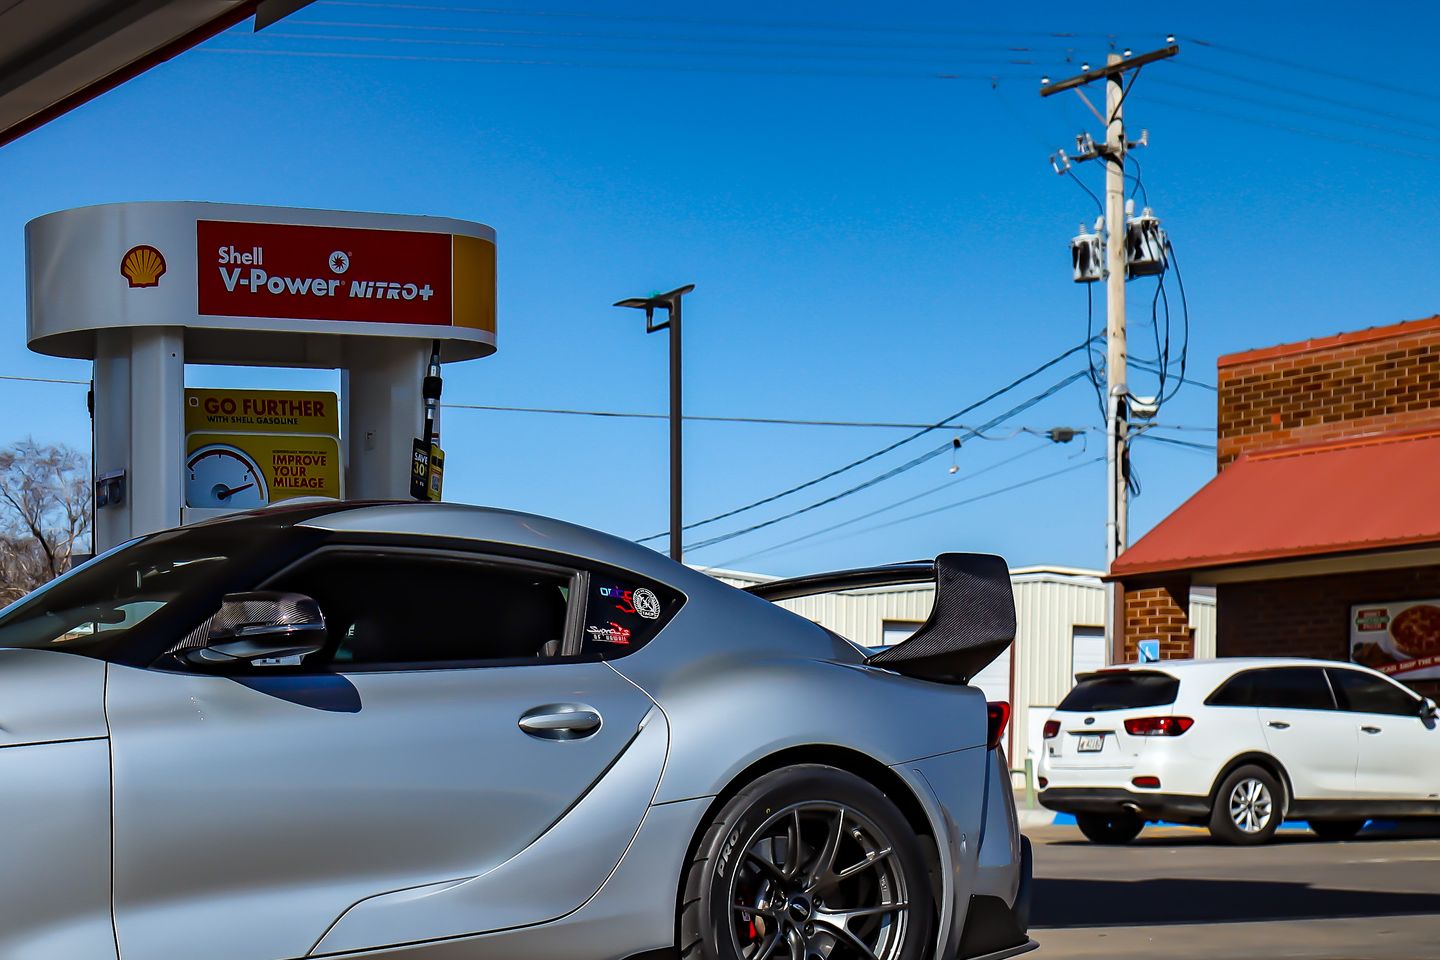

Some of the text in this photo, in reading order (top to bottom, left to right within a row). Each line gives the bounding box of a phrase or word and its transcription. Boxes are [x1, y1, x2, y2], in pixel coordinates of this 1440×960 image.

[218, 245, 263, 265] Shell
[219, 267, 340, 297] V-Power
[204, 397, 326, 417] GO FURTHER
[231, 416, 254, 424] SHELL
[256, 417, 299, 425] GASOLINE
[272, 455, 327, 466] IMPROVE
[414, 451, 428, 465] SAVE
[272, 465, 306, 477] YOUR
[273, 477, 324, 488] MILEAGE
[717, 830, 739, 878] PRO
